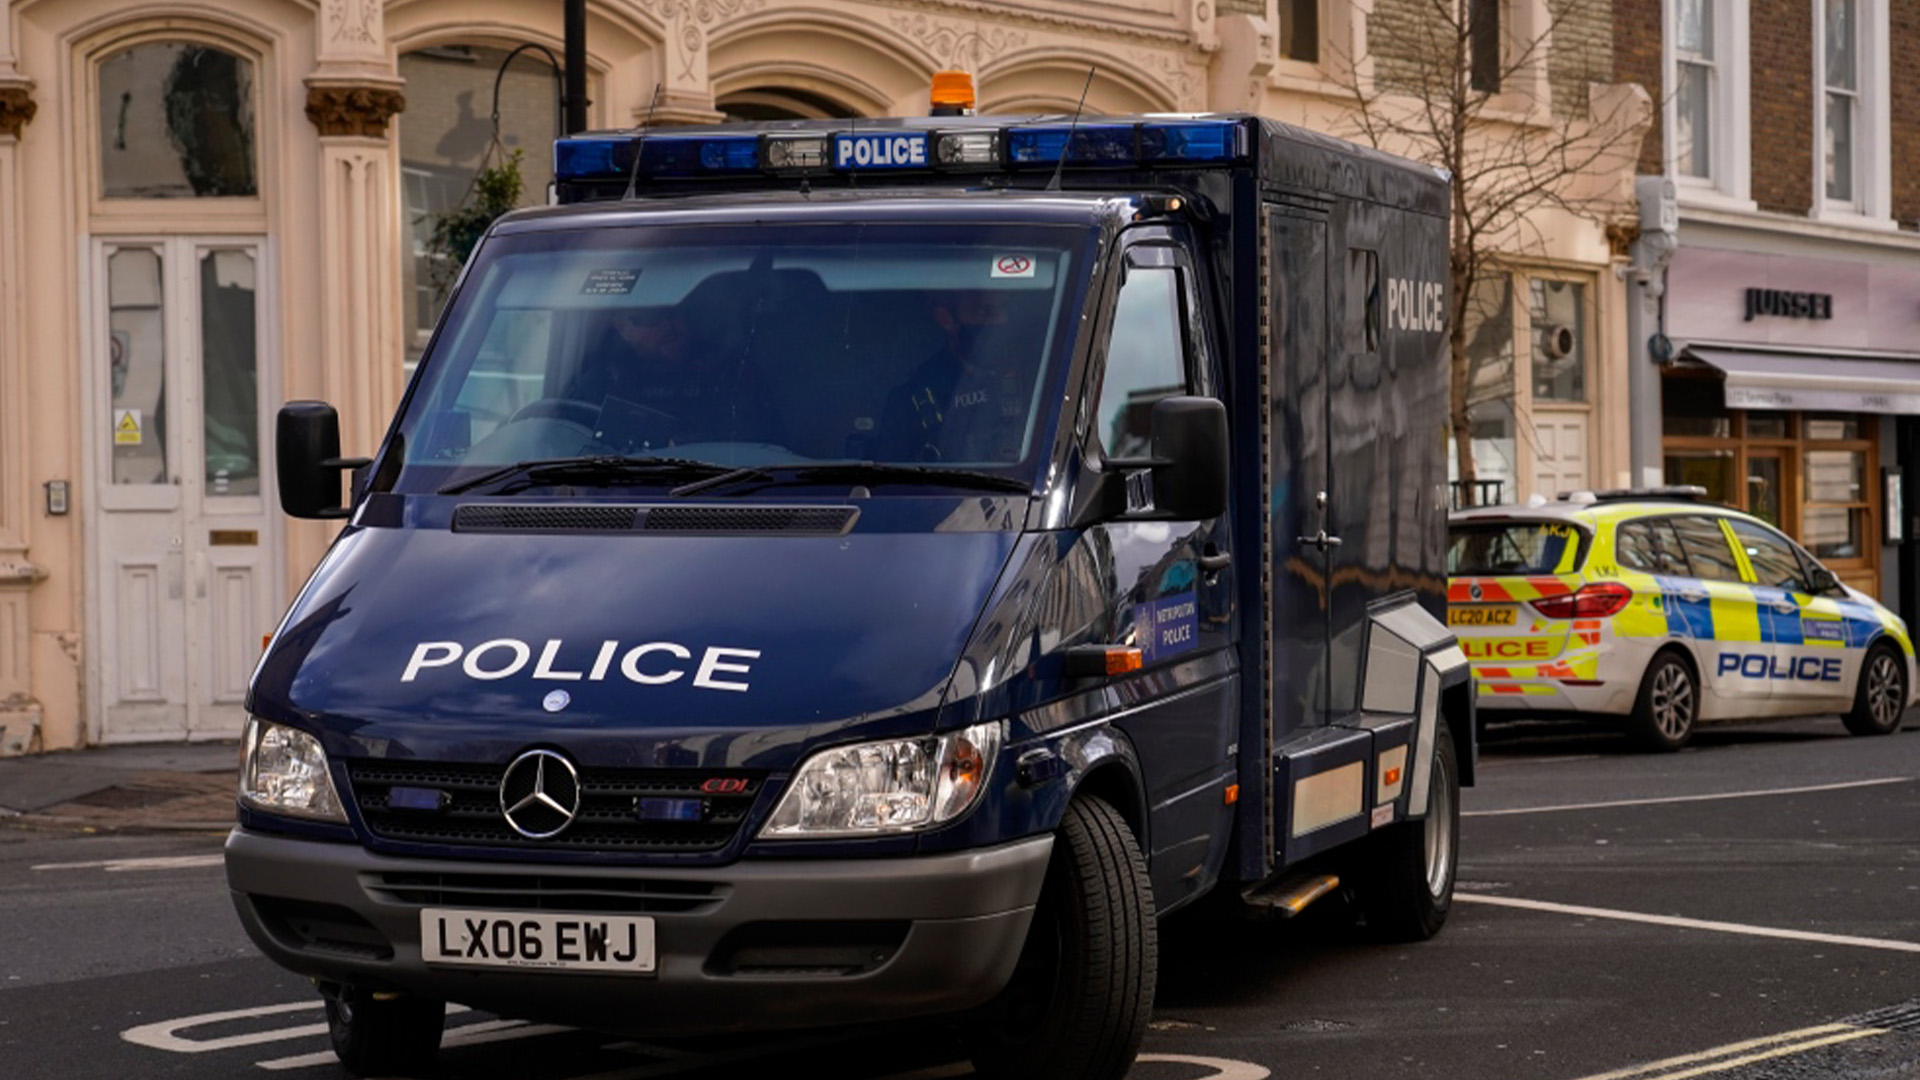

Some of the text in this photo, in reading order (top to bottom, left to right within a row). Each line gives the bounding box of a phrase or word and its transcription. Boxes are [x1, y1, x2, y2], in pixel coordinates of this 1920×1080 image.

[838, 137, 926, 167] POLICE
[1387, 277, 1444, 333] POLICE
[954, 389, 988, 408] POLICE
[1451, 609, 1512, 625] LC20 ACZ
[1162, 624, 1191, 646] POLICE
[1463, 641, 1550, 657] LICE
[400, 638, 762, 692] POLICE
[1717, 651, 1843, 682] POLICE
[700, 777, 750, 794] CDI
[438, 917, 638, 963] LX06 EWJ
